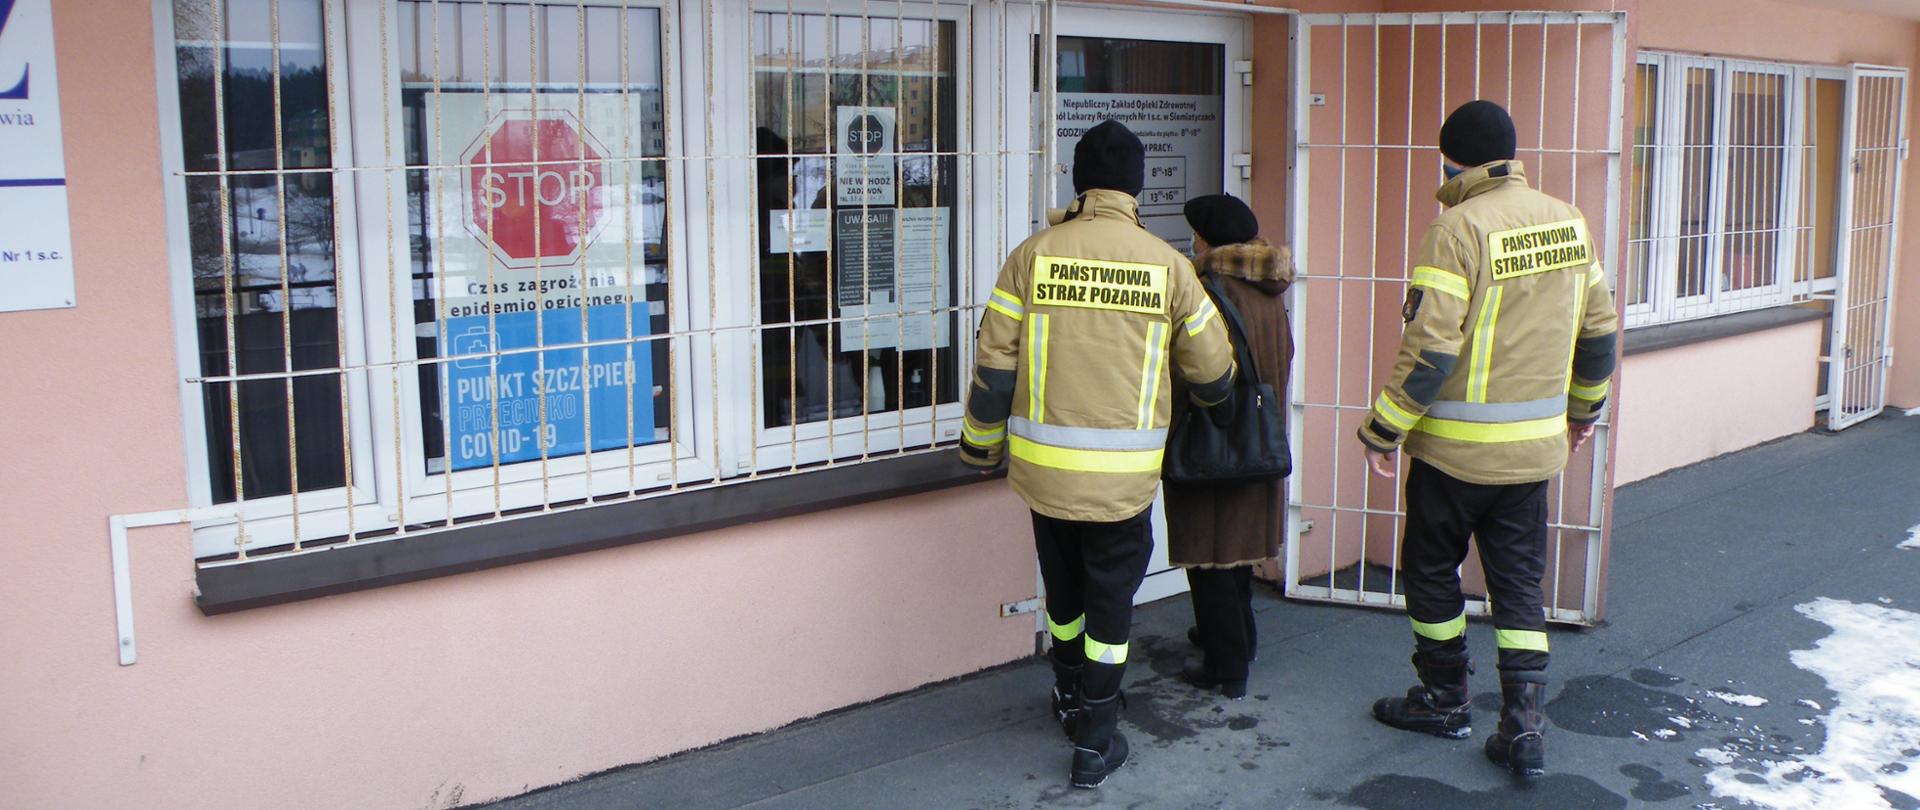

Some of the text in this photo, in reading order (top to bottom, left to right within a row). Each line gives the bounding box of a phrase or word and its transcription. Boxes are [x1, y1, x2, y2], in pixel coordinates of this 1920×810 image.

[1063, 99, 1197, 112] Niepubliczny Zakład Opieki Zdrowotnej
[1068, 112, 1096, 122] Lekarzy
[1097, 112, 1137, 122] Rodzinnych
[1138, 112, 1147, 120] Nr
[849, 130, 882, 143] STOP
[1056, 128, 1089, 138] GODZIN
[480, 170, 595, 209] STOP
[840, 176, 891, 186] NIE WHODŹ
[1501, 226, 1578, 253] PAŃSTWOWA
[3, 250, 63, 262] Nr 1 s.c.
[468, 274, 616, 296] Czas zagrożnia
[1050, 262, 1152, 288] PAŃSTWOWA
[451, 294, 634, 317] epidemioogicnego
[457, 372, 526, 404] PUNKT
[460, 423, 557, 460] COVID-19
